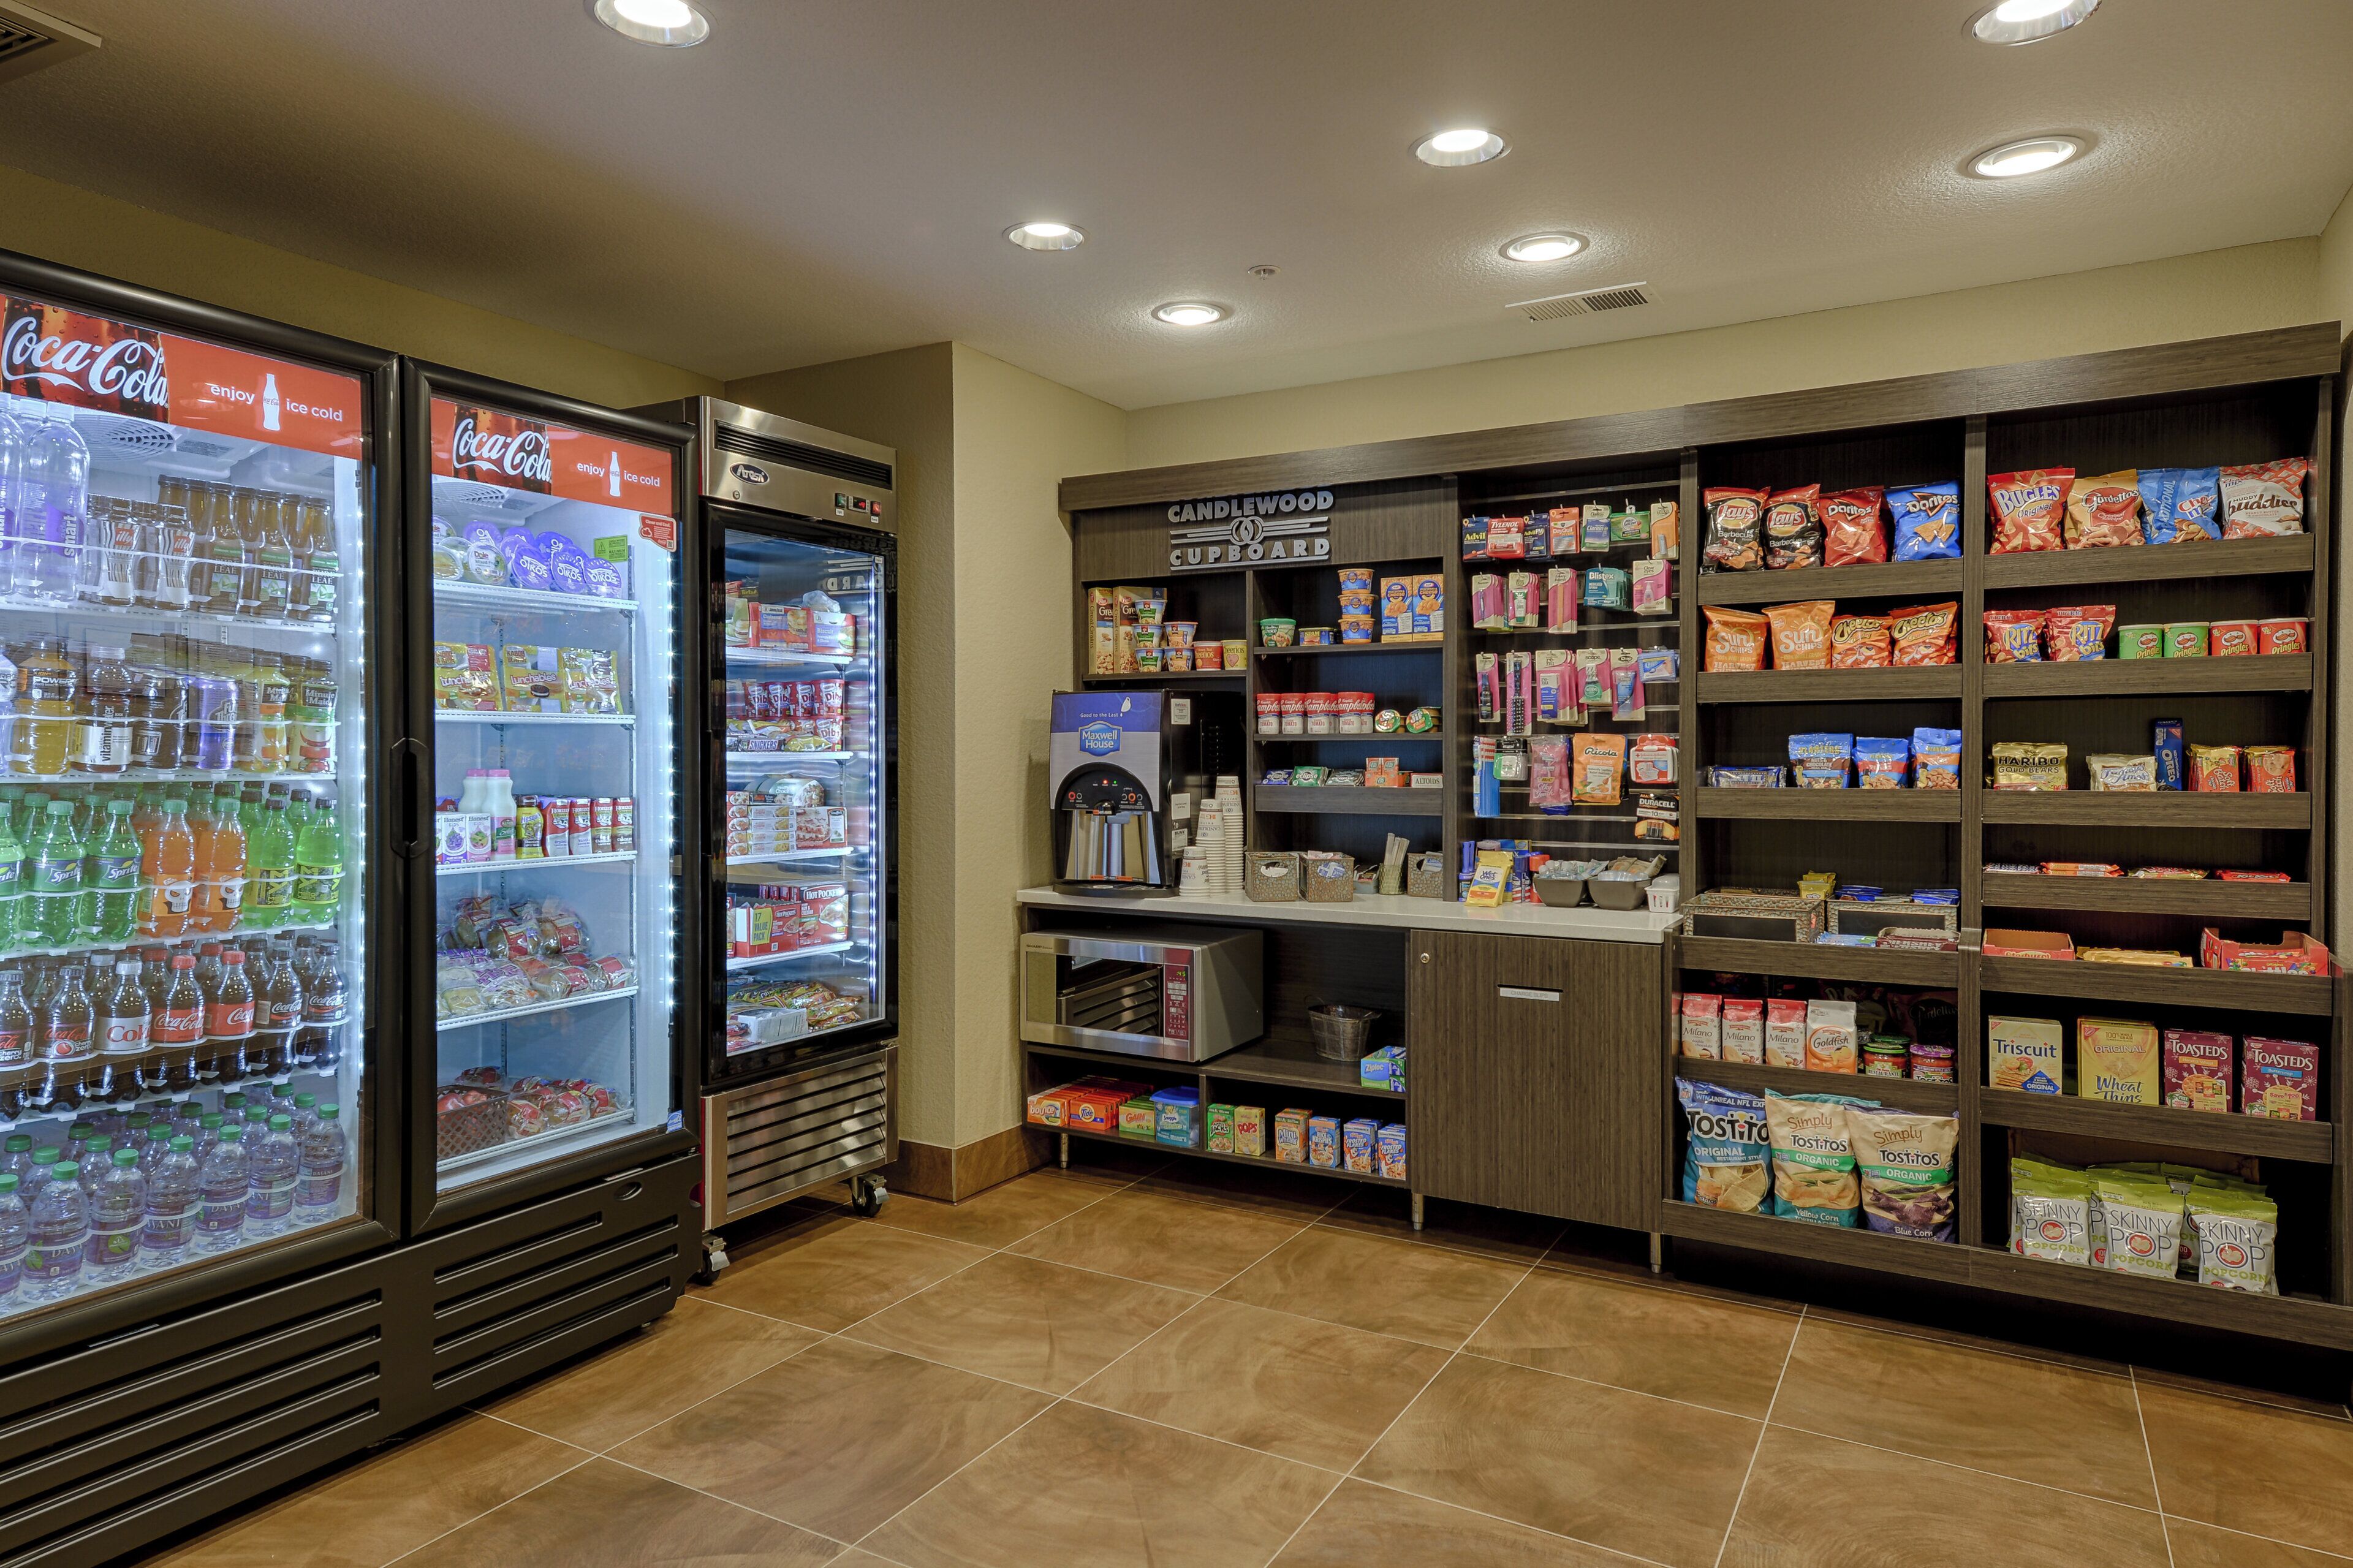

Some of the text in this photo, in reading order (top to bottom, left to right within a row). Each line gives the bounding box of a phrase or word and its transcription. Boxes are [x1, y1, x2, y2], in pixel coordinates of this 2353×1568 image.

[2, 315, 169, 408] Coca-Cola
[210, 384, 343, 422] enjoy ice cold
[452, 417, 552, 485] Coca-Cola
[577, 463, 660, 487] enjoy ice cold
[1168, 491, 1333, 522] CANDLEWOOD
[1906, 494, 1958, 512] Doritos
[1994, 485, 2061, 517] BUGLES
[2227, 494, 2297, 516] buddies
[1828, 504, 1873, 517] Doritos
[116, 531, 133, 544] illy
[174, 537, 191, 549] illy
[474, 551, 489, 559] Dole
[1170, 538, 1330, 566] CUPBOARD
[312, 576, 333, 585] LEAF
[1589, 572, 1614, 581] Blistex
[1832, 618, 1882, 643] Cheetos
[1893, 611, 1948, 640] Cheetos
[1779, 627, 1817, 654] Sun
[2006, 627, 2036, 650] RITZ
[2072, 624, 2104, 646] RITZ
[1716, 632, 1749, 654] Sun
[1795, 642, 1822, 650] CHIPS
[2221, 643, 2249, 656] Pringles
[2272, 642, 2301, 654] Pringles
[306, 690, 335, 699] Minute
[827, 692, 842, 701] Dibs
[1082, 730, 1117, 740] Maxwell
[748, 740, 778, 749] SNICKERS
[1085, 740, 1114, 749] House
[1585, 747, 1618, 756] Ricola
[1998, 756, 2059, 765] HARIBO
[2161, 749, 2175, 782] OREO
[2223, 771, 2234, 789] Soft
[1639, 798, 1675, 808] DURACELL
[51, 866, 82, 882] Sprite
[108, 865, 139, 879] Sprite
[806, 890, 817, 900] HOT
[755, 922, 768, 931] VALUE
[754, 932, 765, 941] PACK
[1683, 1027, 1713, 1037] Milano
[1725, 1032, 1756, 1041] Milano
[1767, 1033, 1799, 1043] Milano
[1813, 1036, 1849, 1047] Goldfish
[1993, 1039, 2057, 1058] Triscuit
[2169, 1039, 2228, 1059] TOASTEDS
[2251, 1048, 2314, 1070] TOASTEDS
[1365, 1063, 1384, 1073] Ziploc
[2095, 1075, 2144, 1093] Wheat
[1711, 1096, 1735, 1105] UNREAL
[1737, 1098, 1751, 1107] NFL
[1030, 1104, 1055, 1115] bounce
[1081, 1108, 1094, 1118] Tide
[1237, 1123, 1257, 1134] POPS
[1686, 1108, 1770, 1145] TOSTITO
[1787, 1113, 1832, 1132] Simply
[1874, 1126, 1922, 1145] Simply
[1790, 1134, 1849, 1153] TOSTITOS
[1694, 1147, 1745, 1156] ORIGINAL
[1879, 1148, 1941, 1166] TOSTITOS
[1796, 1153, 1840, 1167] ORGANIC
[1887, 1169, 1932, 1181] ORGANIC
[1795, 1208, 1839, 1222] Yellow Corn
[2023, 1202, 2080, 1221] SKINNY
[2110, 1210, 2172, 1233] SKINNY
[1895, 1226, 1912, 1236] Blue
[2025, 1219, 2083, 1243] POP
[2199, 1221, 2263, 1244] SKINNY
[2024, 1242, 2085, 1254] POPCORN
[2110, 1228, 2172, 1260] POP
[2112, 1254, 2172, 1271] POPCORN
[2200, 1240, 2265, 1271] POP
[2204, 1267, 2267, 1282] POPCORN
